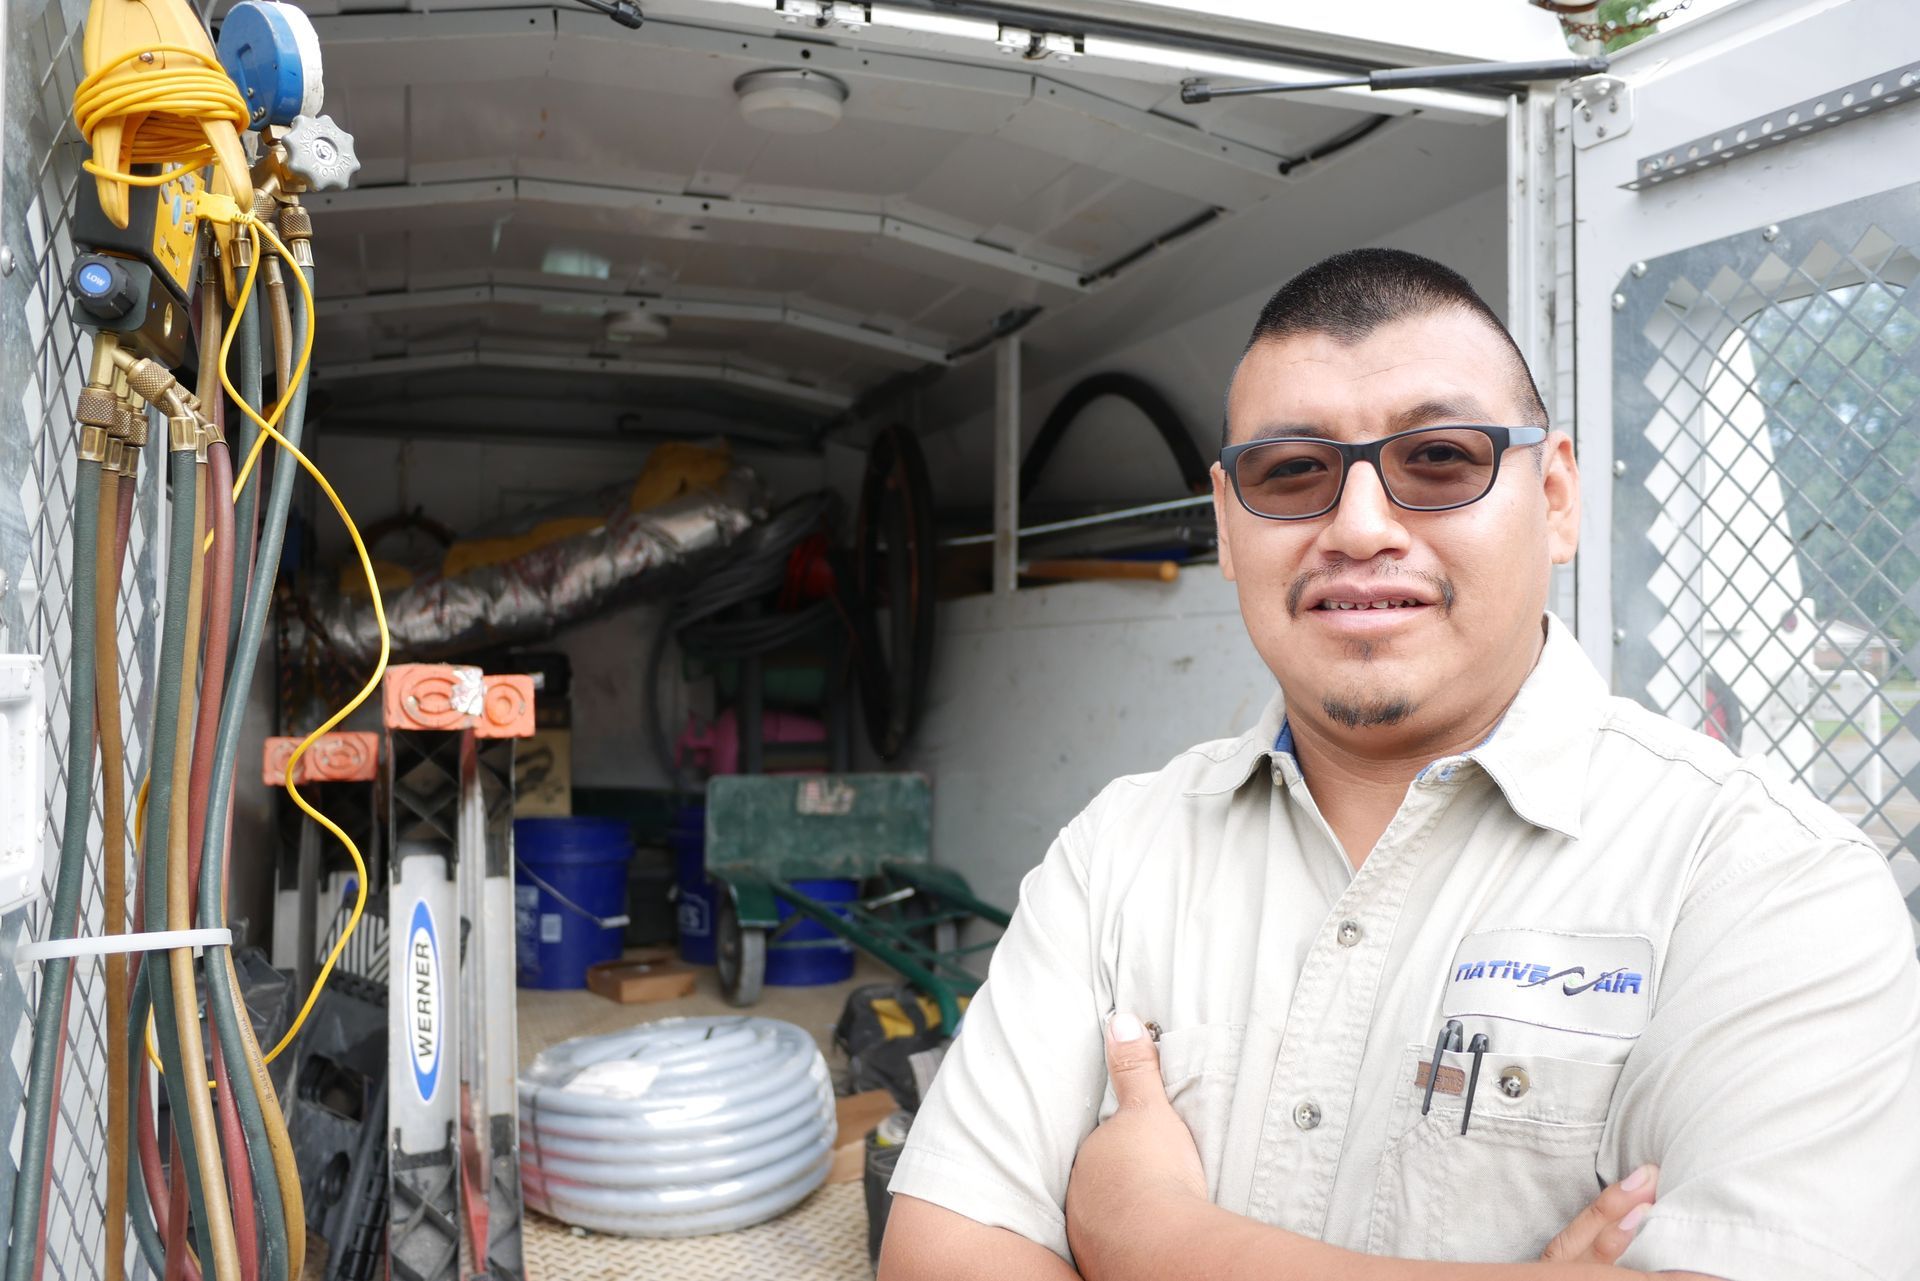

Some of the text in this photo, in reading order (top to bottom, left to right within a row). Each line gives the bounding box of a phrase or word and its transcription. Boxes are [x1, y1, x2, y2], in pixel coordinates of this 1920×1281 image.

[86, 272, 105, 286] LOW
[1455, 960, 1643, 994] NATIVE AIR
[415, 941, 433, 1058] WERNER
